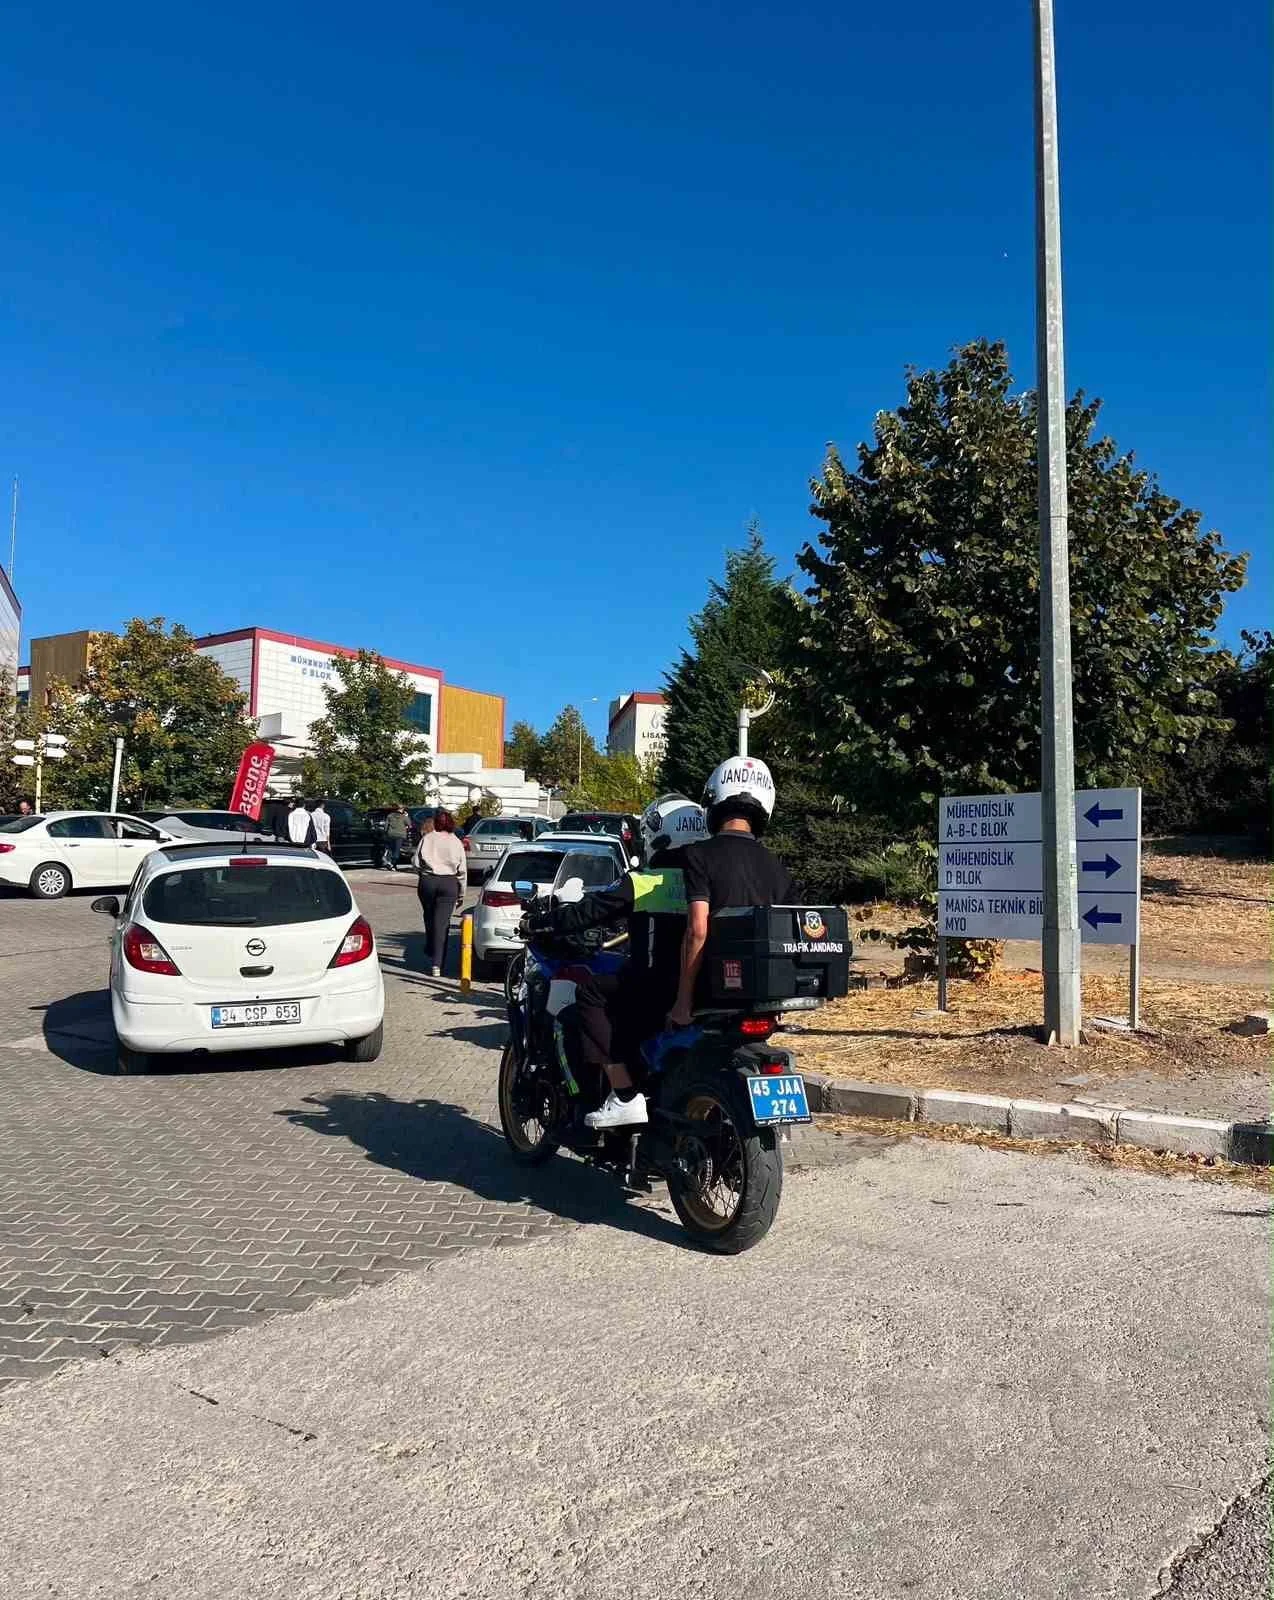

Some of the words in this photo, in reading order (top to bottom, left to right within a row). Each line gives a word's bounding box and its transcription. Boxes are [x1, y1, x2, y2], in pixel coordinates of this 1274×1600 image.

[946, 800, 1015, 819] MÜHENDİSLİK
[946, 823, 978, 837] A-B-C
[981, 822, 1008, 837] BLOK
[946, 849, 1014, 866] MÜHENDİSLİK
[946, 871, 952, 884] D
[956, 870, 982, 885] BLOK
[945, 896, 985, 913] MANİSA
[988, 897, 1026, 914] TEKNİK
[945, 917, 967, 932] MYO
[222, 1008, 236, 1022] 34
[245, 1006, 267, 1020] CSP
[275, 1005, 298, 1019] 653
[753, 1080, 770, 1096] 45
[776, 1079, 801, 1095] JAA
[771, 1099, 797, 1115] 274
